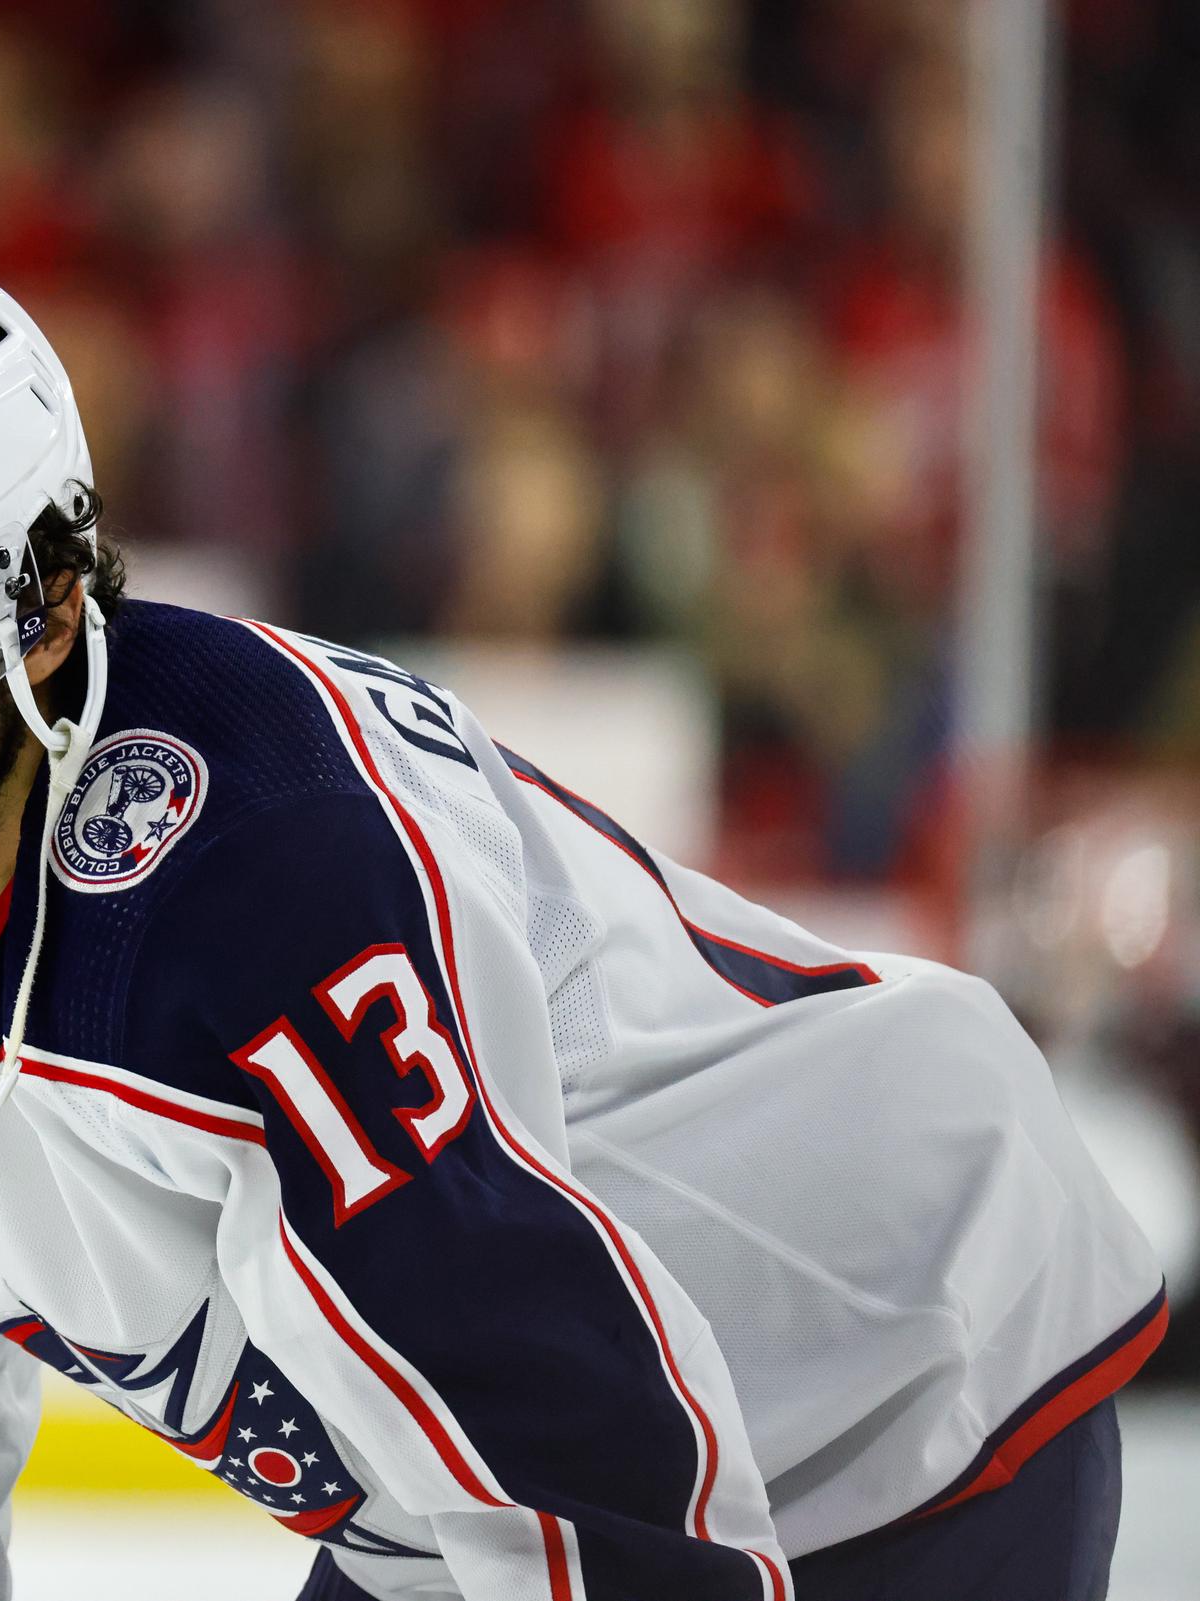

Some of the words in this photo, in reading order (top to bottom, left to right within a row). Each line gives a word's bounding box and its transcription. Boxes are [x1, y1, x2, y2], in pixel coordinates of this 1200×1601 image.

[21, 623, 46, 640] OAKLEY
[70, 757, 110, 806] BLUE
[116, 746, 188, 784] JACKETS
[60, 812, 120, 873] COLUMBUS
[227, 942, 476, 1231] 13
